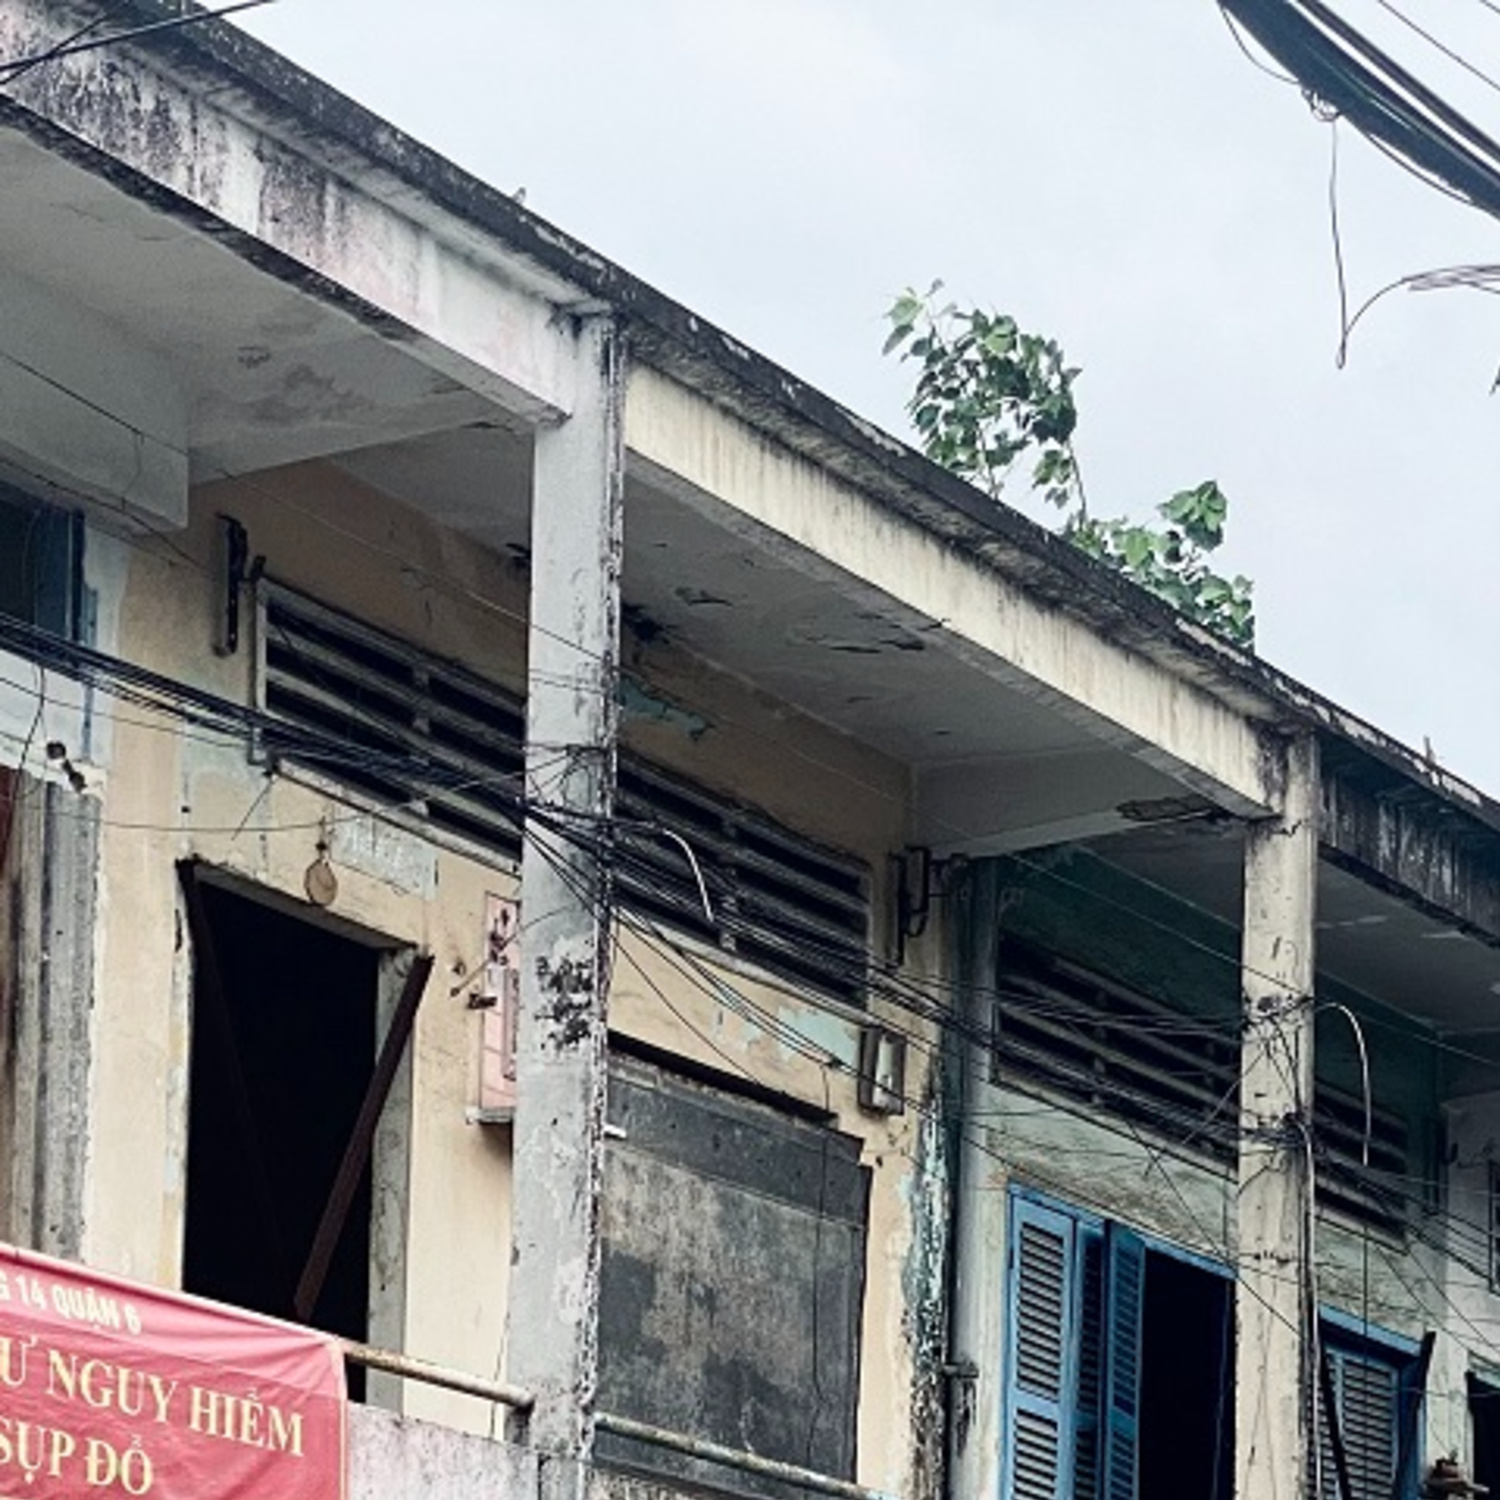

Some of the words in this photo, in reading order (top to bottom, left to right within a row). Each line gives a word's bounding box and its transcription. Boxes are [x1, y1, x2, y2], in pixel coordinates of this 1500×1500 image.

[15, 1274, 47, 1310] 14
[124, 1302, 142, 1335] 6
[45, 1348, 178, 1424] NGUY
[188, 1386, 305, 1457] HIỂM
[84, 1433, 153, 1495] ĐỔ
